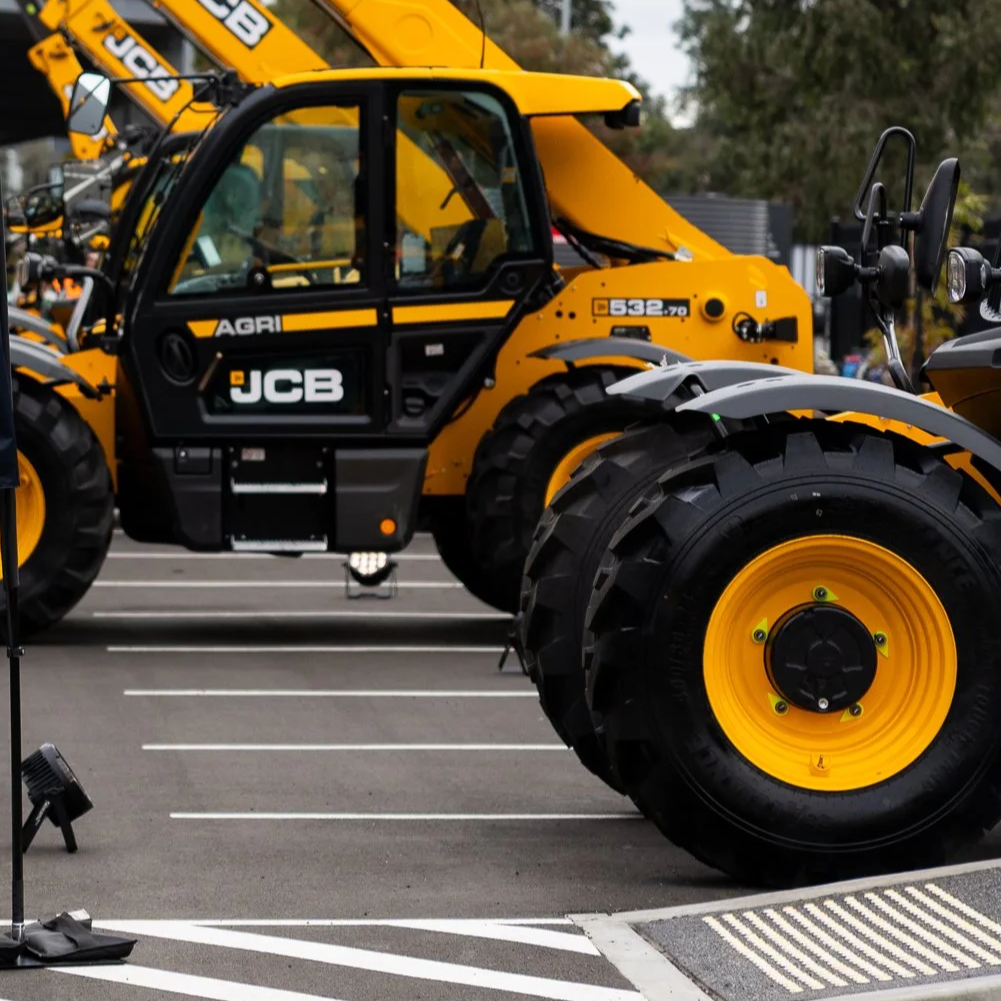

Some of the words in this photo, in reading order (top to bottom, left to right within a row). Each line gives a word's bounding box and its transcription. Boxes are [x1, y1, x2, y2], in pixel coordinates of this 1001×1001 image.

[103, 33, 179, 100] JCB
[214, 314, 282, 338] AGRI
[229, 369, 344, 403] JCB
